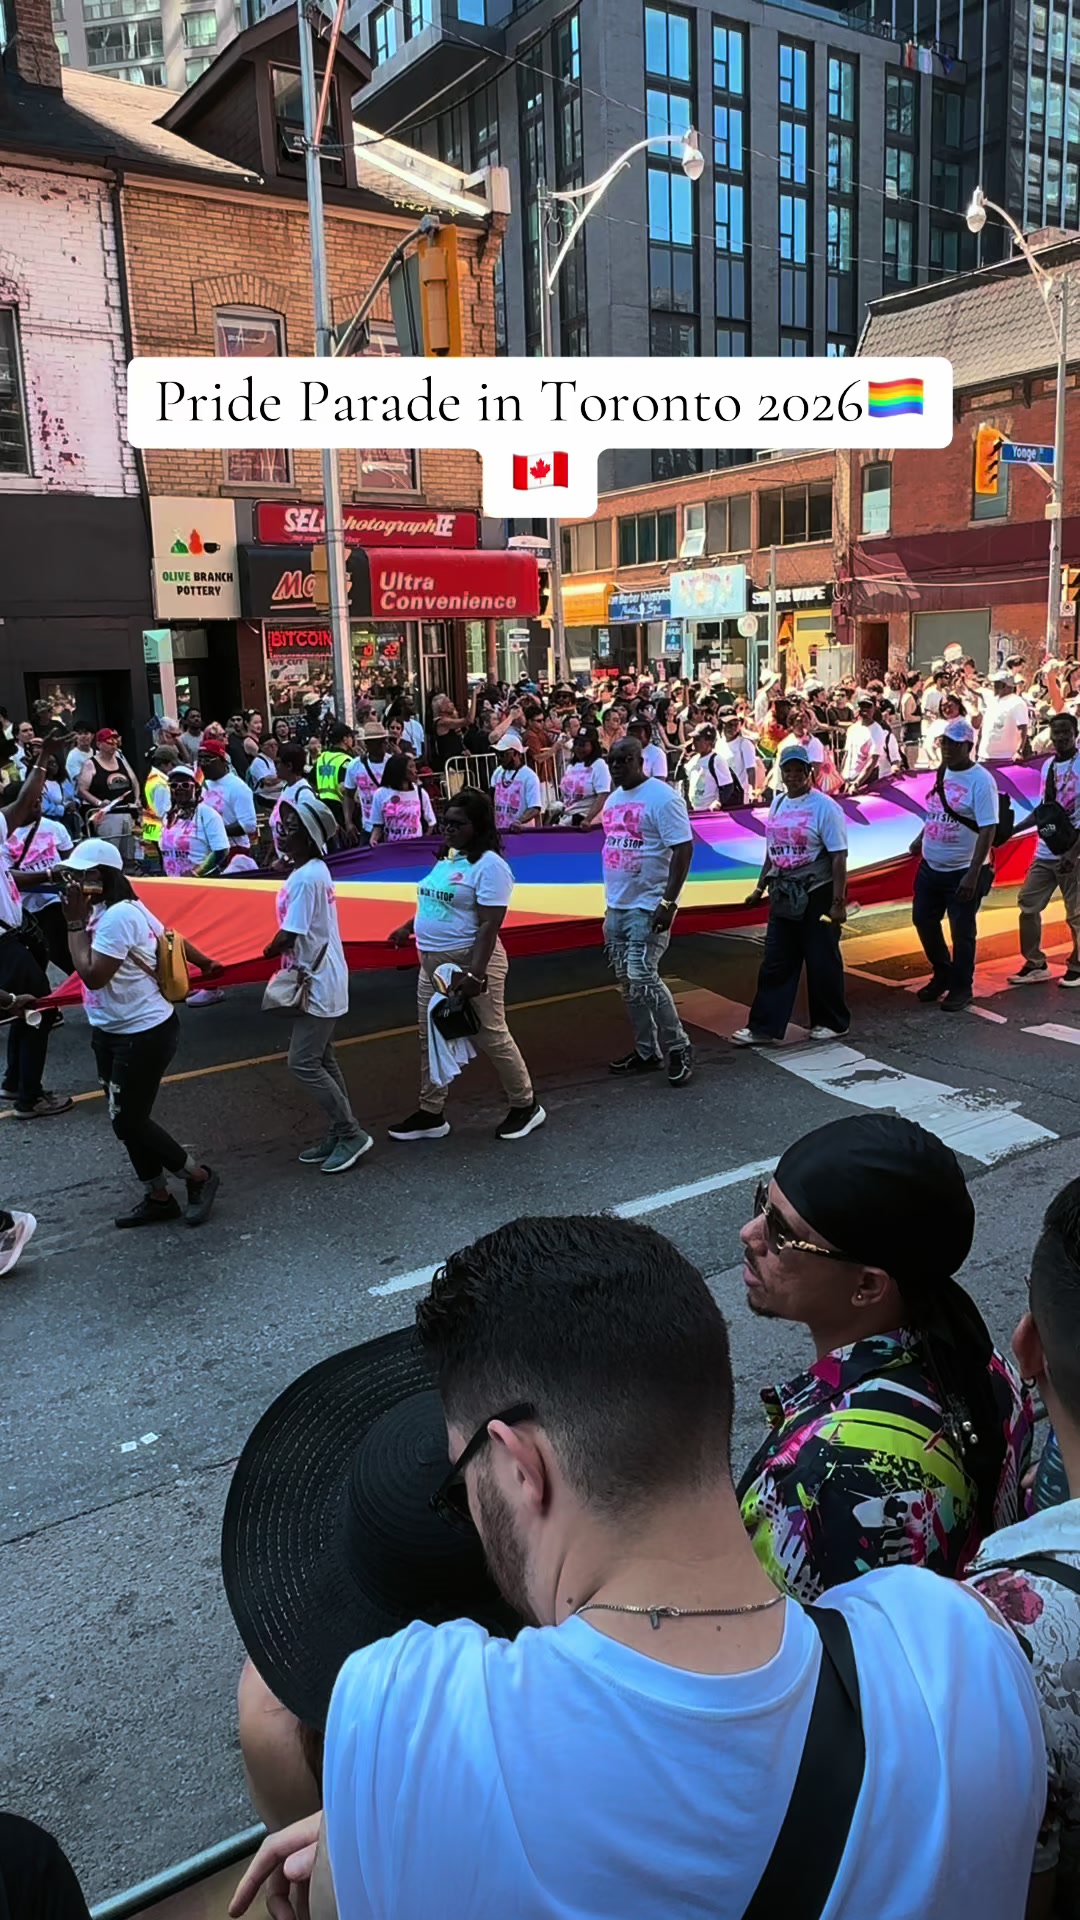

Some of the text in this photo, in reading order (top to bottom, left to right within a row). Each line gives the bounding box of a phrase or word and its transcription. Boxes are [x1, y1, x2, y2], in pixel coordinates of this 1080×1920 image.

[1012, 445, 1036, 462] Yonge
[162, 571, 234, 582] OLIVE BRANCH
[380, 571, 435, 591] Ultra
[176, 585, 222, 596] POTTERY
[380, 591, 517, 610] Convenience
[271, 632, 332, 647] BITCOIN
[623, 838, 644, 849] STOP
[436, 890, 455, 902] STOP
